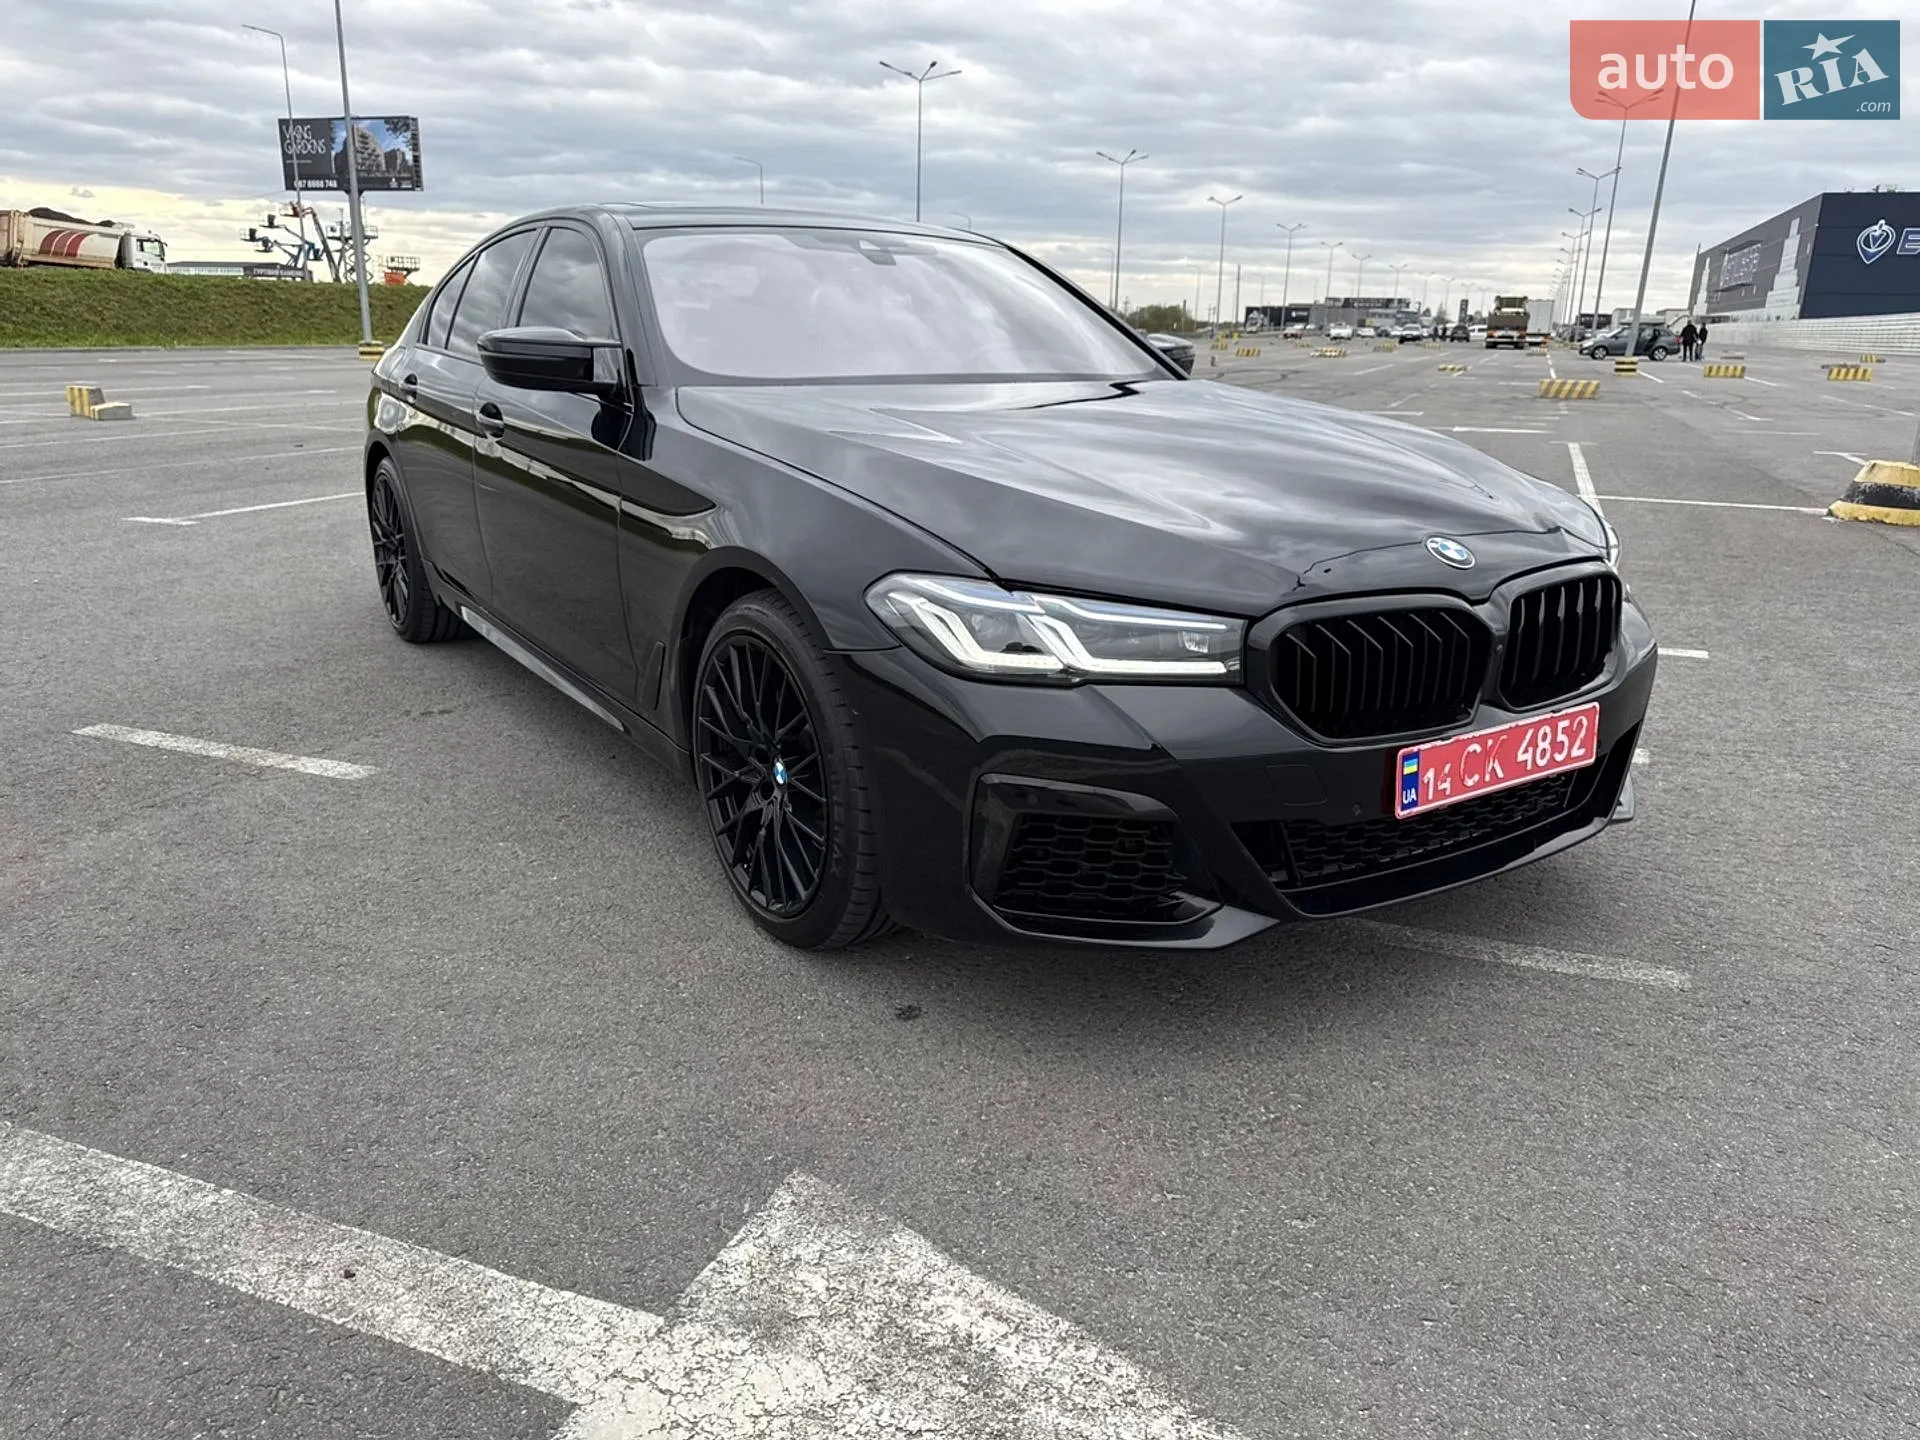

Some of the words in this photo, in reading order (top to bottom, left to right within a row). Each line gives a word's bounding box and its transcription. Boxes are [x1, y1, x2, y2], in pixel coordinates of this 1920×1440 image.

[1423, 763, 1452, 801] 14
[1459, 735, 1508, 788] CK
[1516, 714, 1589, 771] 4852
[1402, 788, 1417, 805] UA
